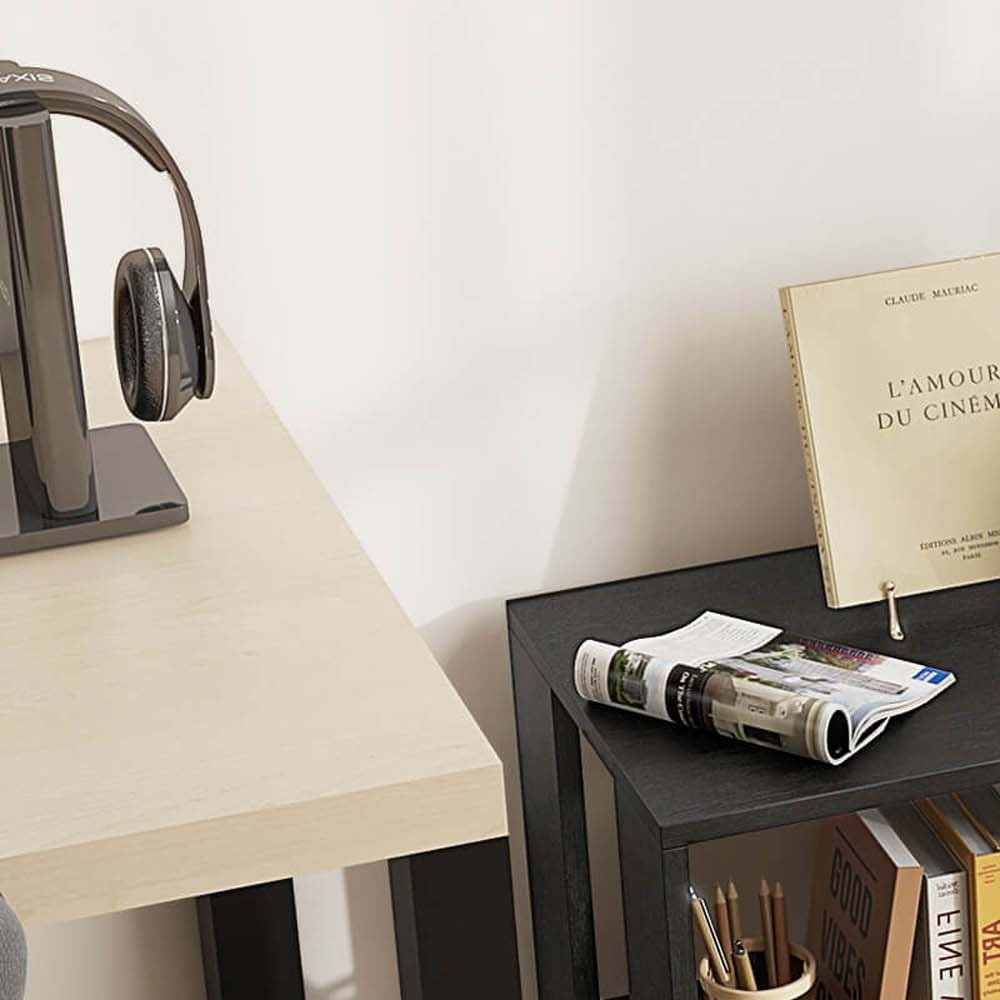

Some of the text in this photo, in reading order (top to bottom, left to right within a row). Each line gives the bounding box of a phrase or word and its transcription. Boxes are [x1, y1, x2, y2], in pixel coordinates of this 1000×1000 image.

[884, 283, 979, 307] CLAUDE MAURIAC
[877, 407, 912, 430] DU
[829, 847, 873, 940] GOOD
